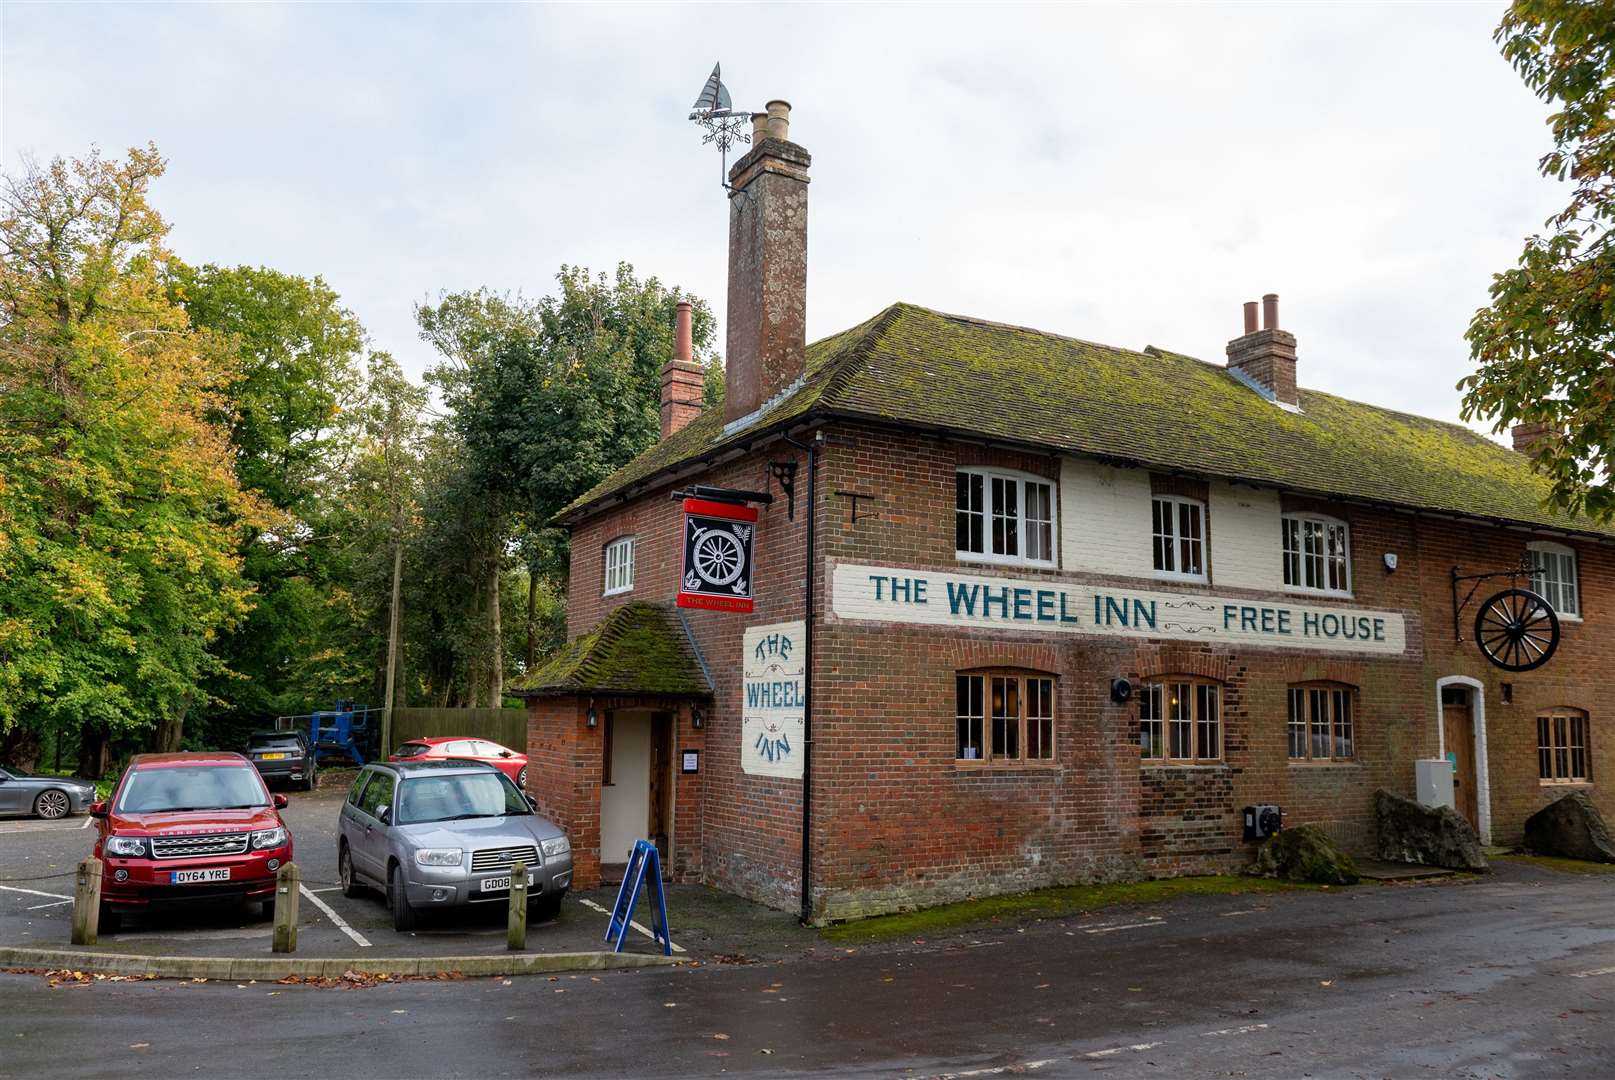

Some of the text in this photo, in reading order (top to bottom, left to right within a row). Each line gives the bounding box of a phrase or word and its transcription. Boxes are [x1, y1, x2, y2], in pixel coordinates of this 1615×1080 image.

[706, 599, 733, 608] WHEEL
[869, 575, 1385, 641] THE WHEEL INN FREE HOUSE
[755, 633, 792, 660] THE
[747, 680, 804, 708] WHEEL
[755, 733, 791, 762] INN
[178, 869, 228, 882] OY64 YRE
